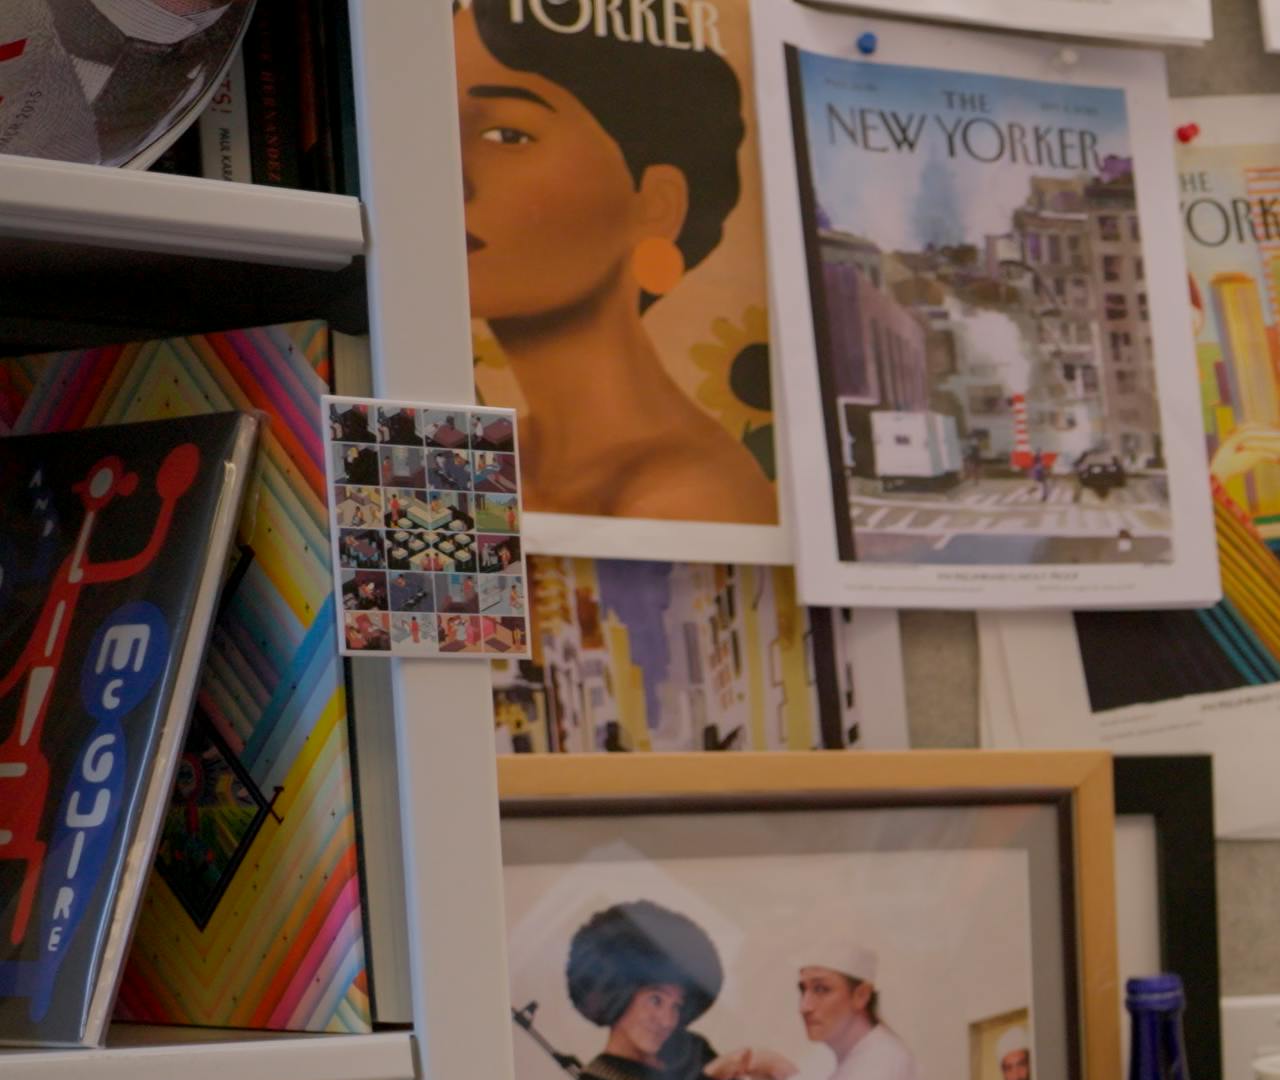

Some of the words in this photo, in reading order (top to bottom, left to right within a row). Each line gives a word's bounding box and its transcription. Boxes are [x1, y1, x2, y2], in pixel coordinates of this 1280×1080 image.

[942, 89, 991, 114] THE
[825, 102, 926, 154] NEW
[936, 113, 1109, 172] YORKER
[1178, 170, 1213, 193] HE
